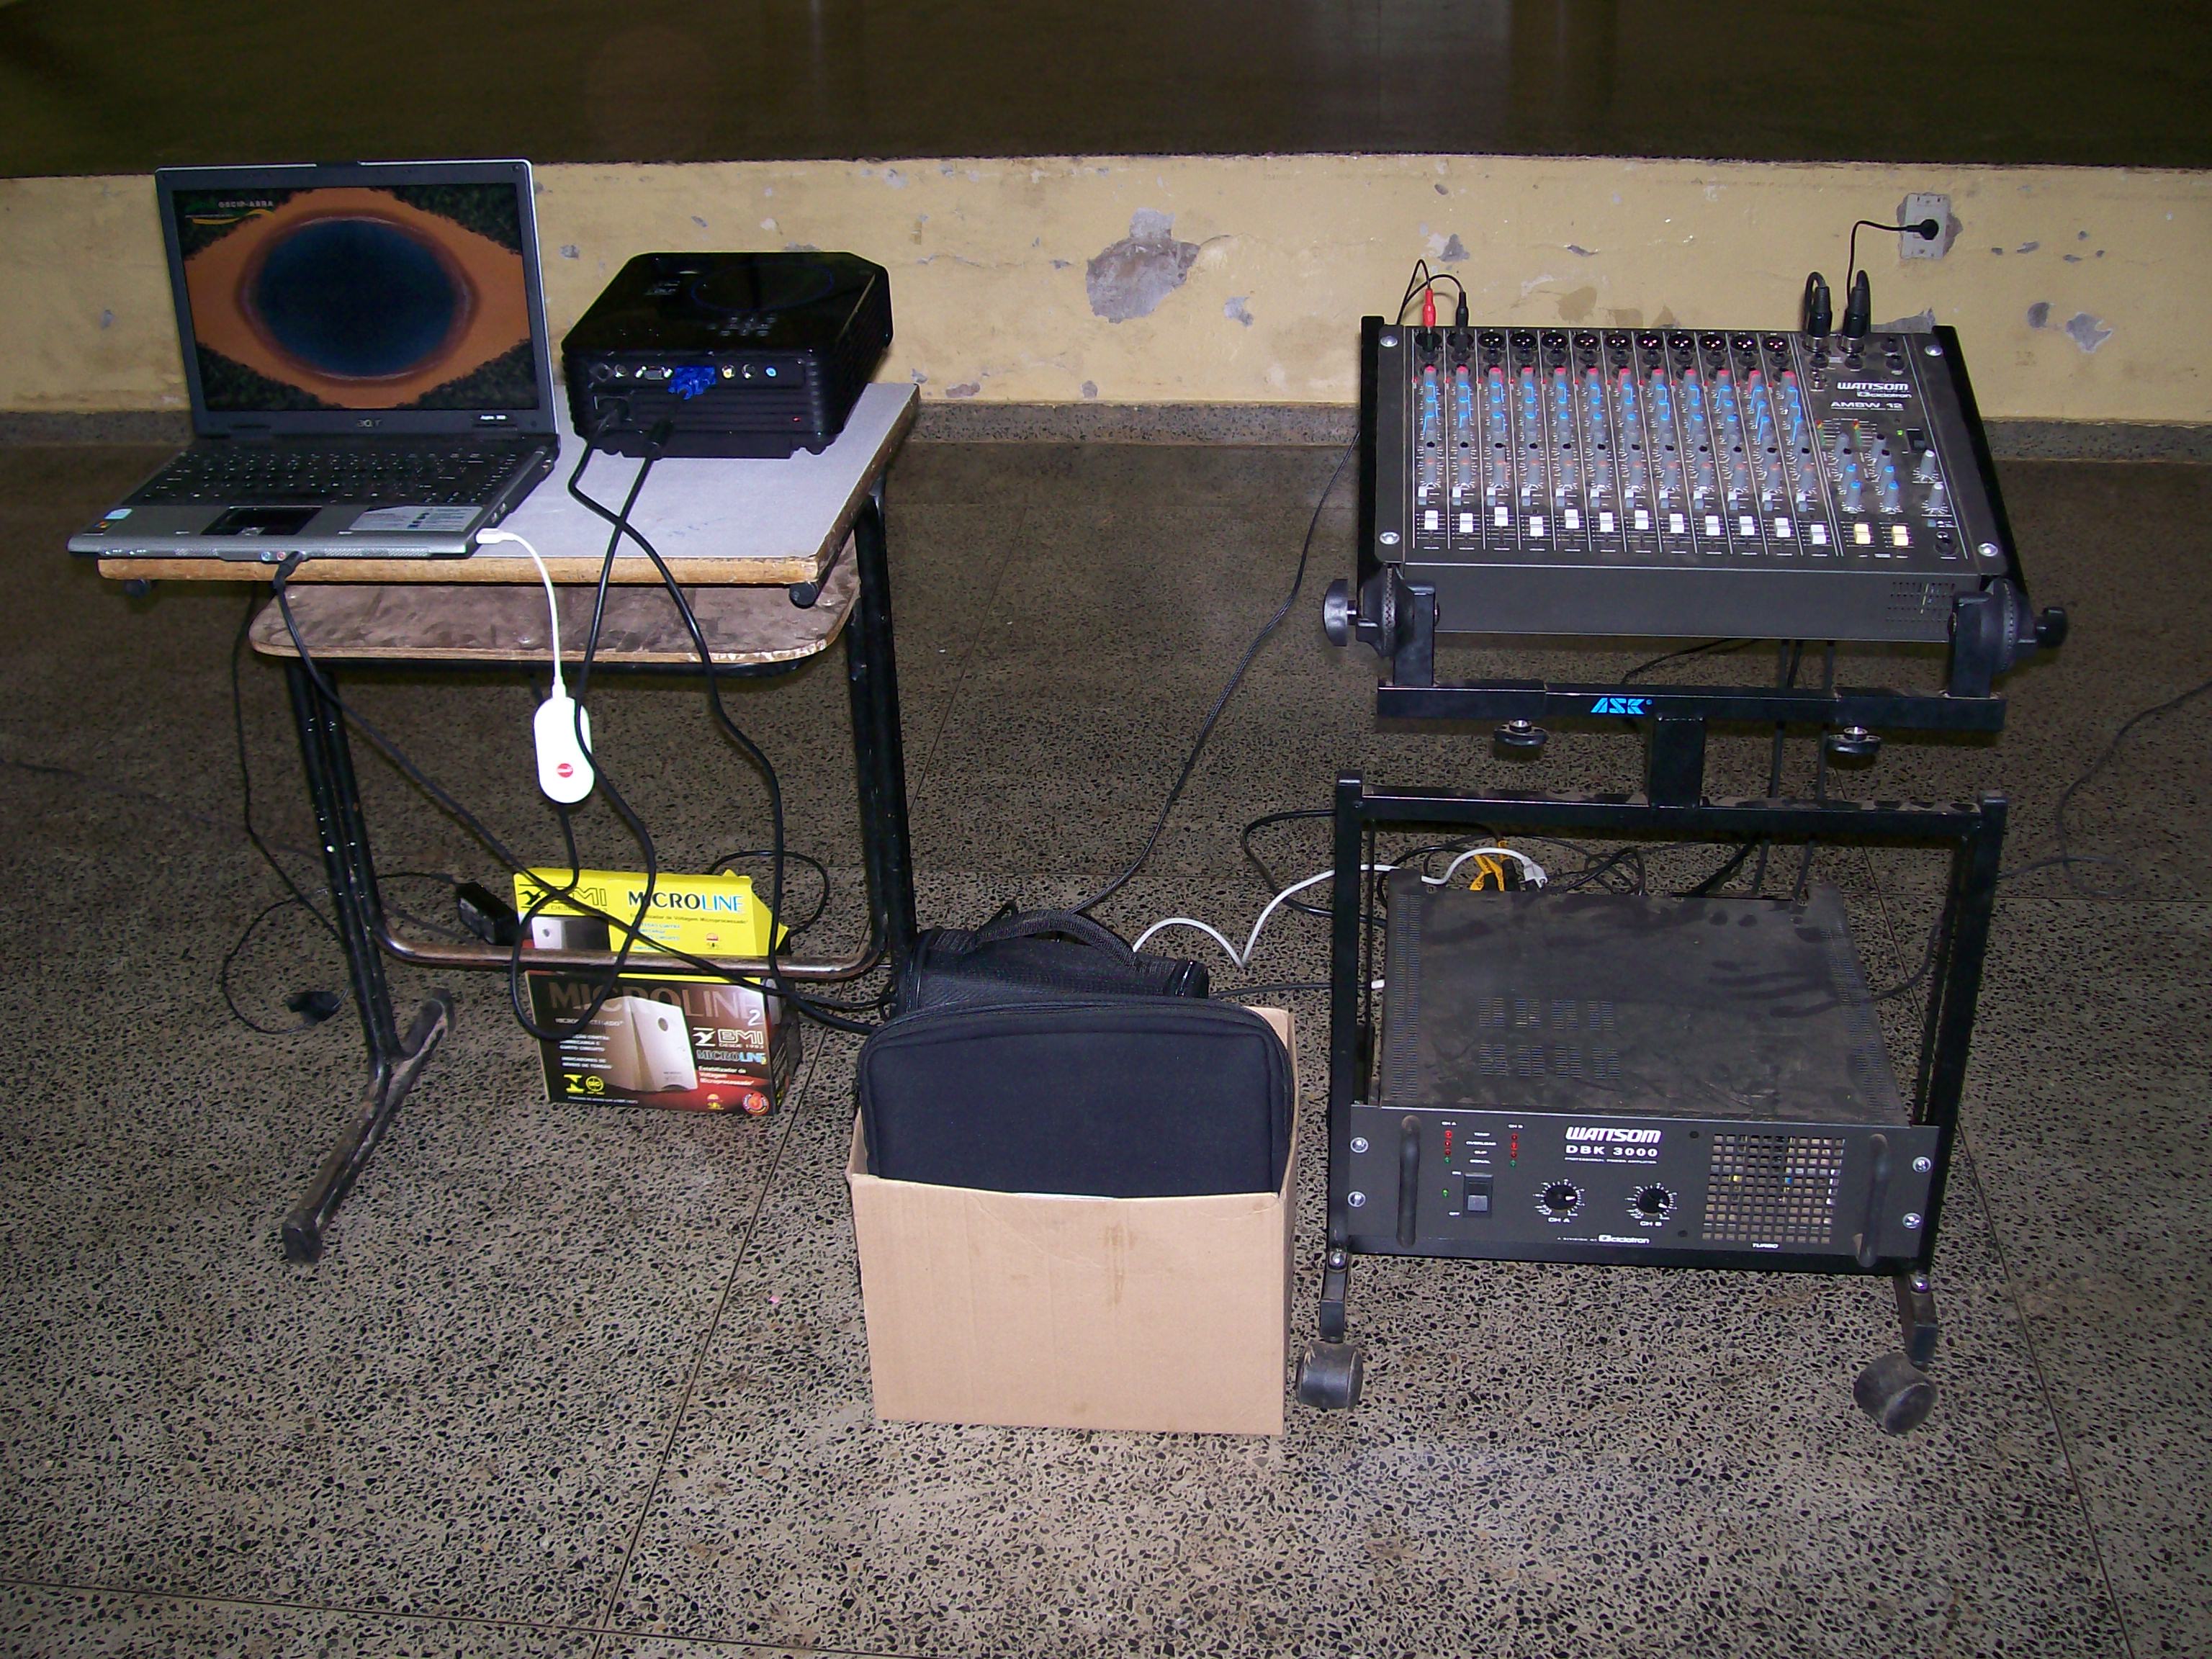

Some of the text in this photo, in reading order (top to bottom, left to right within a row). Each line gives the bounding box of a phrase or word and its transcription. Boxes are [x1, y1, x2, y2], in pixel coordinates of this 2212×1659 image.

[1837, 382, 1909, 390] WATTSOM
[1591, 697, 1645, 714] ASK
[628, 891, 743, 912] MCROLINE
[747, 1010, 764, 1026] 2
[717, 1028, 764, 1045] BMI
[696, 1049, 765, 1063] MICROLINE
[1565, 1126, 1662, 1143] WATTSOM
[1565, 1144, 1658, 1157] DBK 3000
